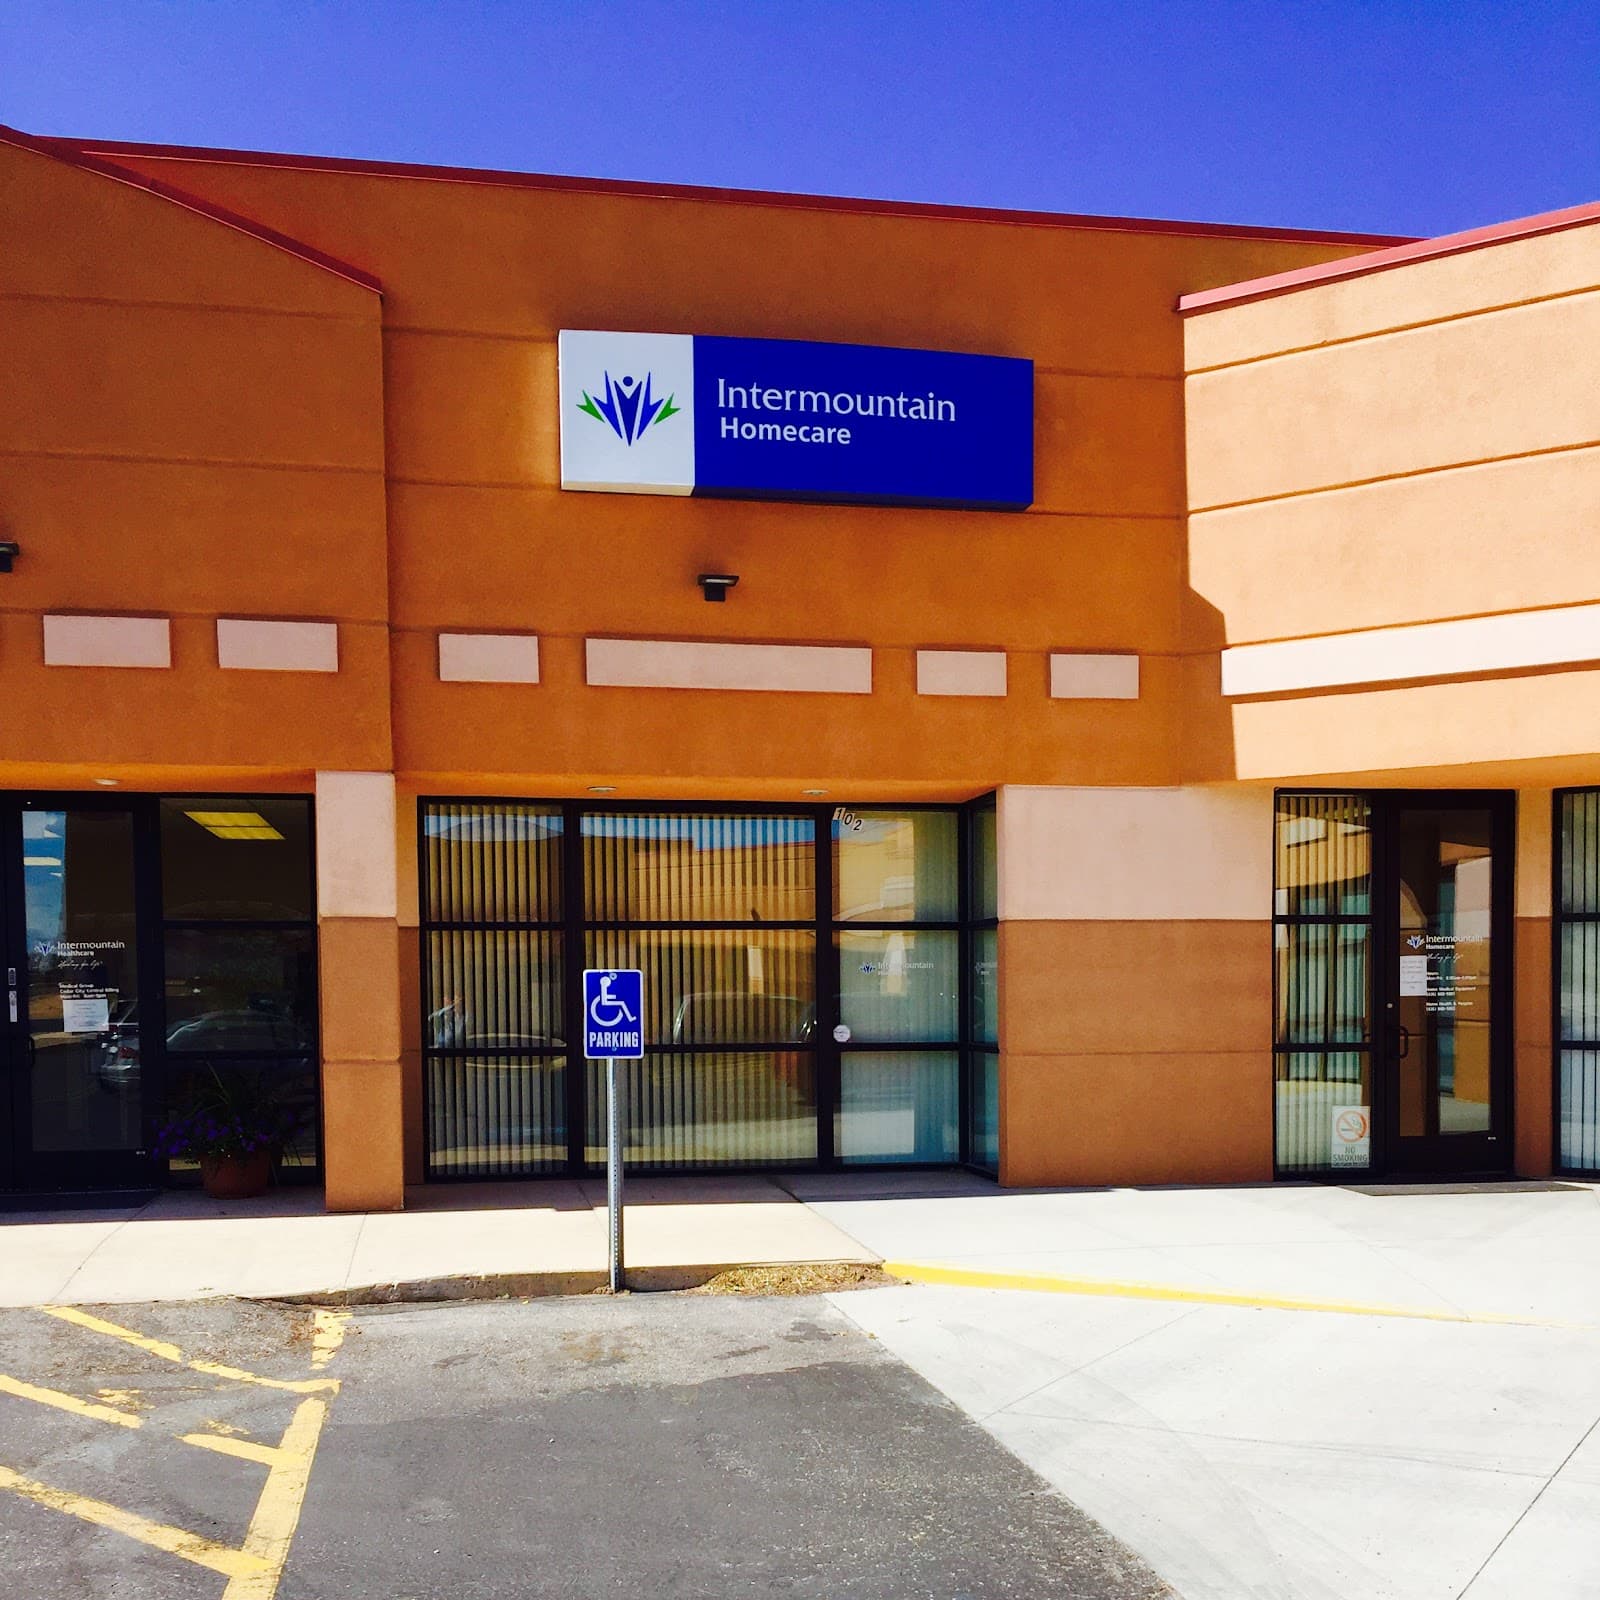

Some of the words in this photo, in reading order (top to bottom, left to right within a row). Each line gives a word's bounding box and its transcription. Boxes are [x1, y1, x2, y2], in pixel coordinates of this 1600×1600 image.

[717, 378, 956, 422] Intermountain
[720, 416, 851, 445] Homecare
[835, 807, 862, 831] 102
[57, 940, 125, 950] Intermountain
[1425, 934, 1483, 944] Intermountain
[589, 1031, 639, 1048] PARKING
[1345, 1145, 1356, 1154] NO
[1332, 1153, 1368, 1162] SMOKING
